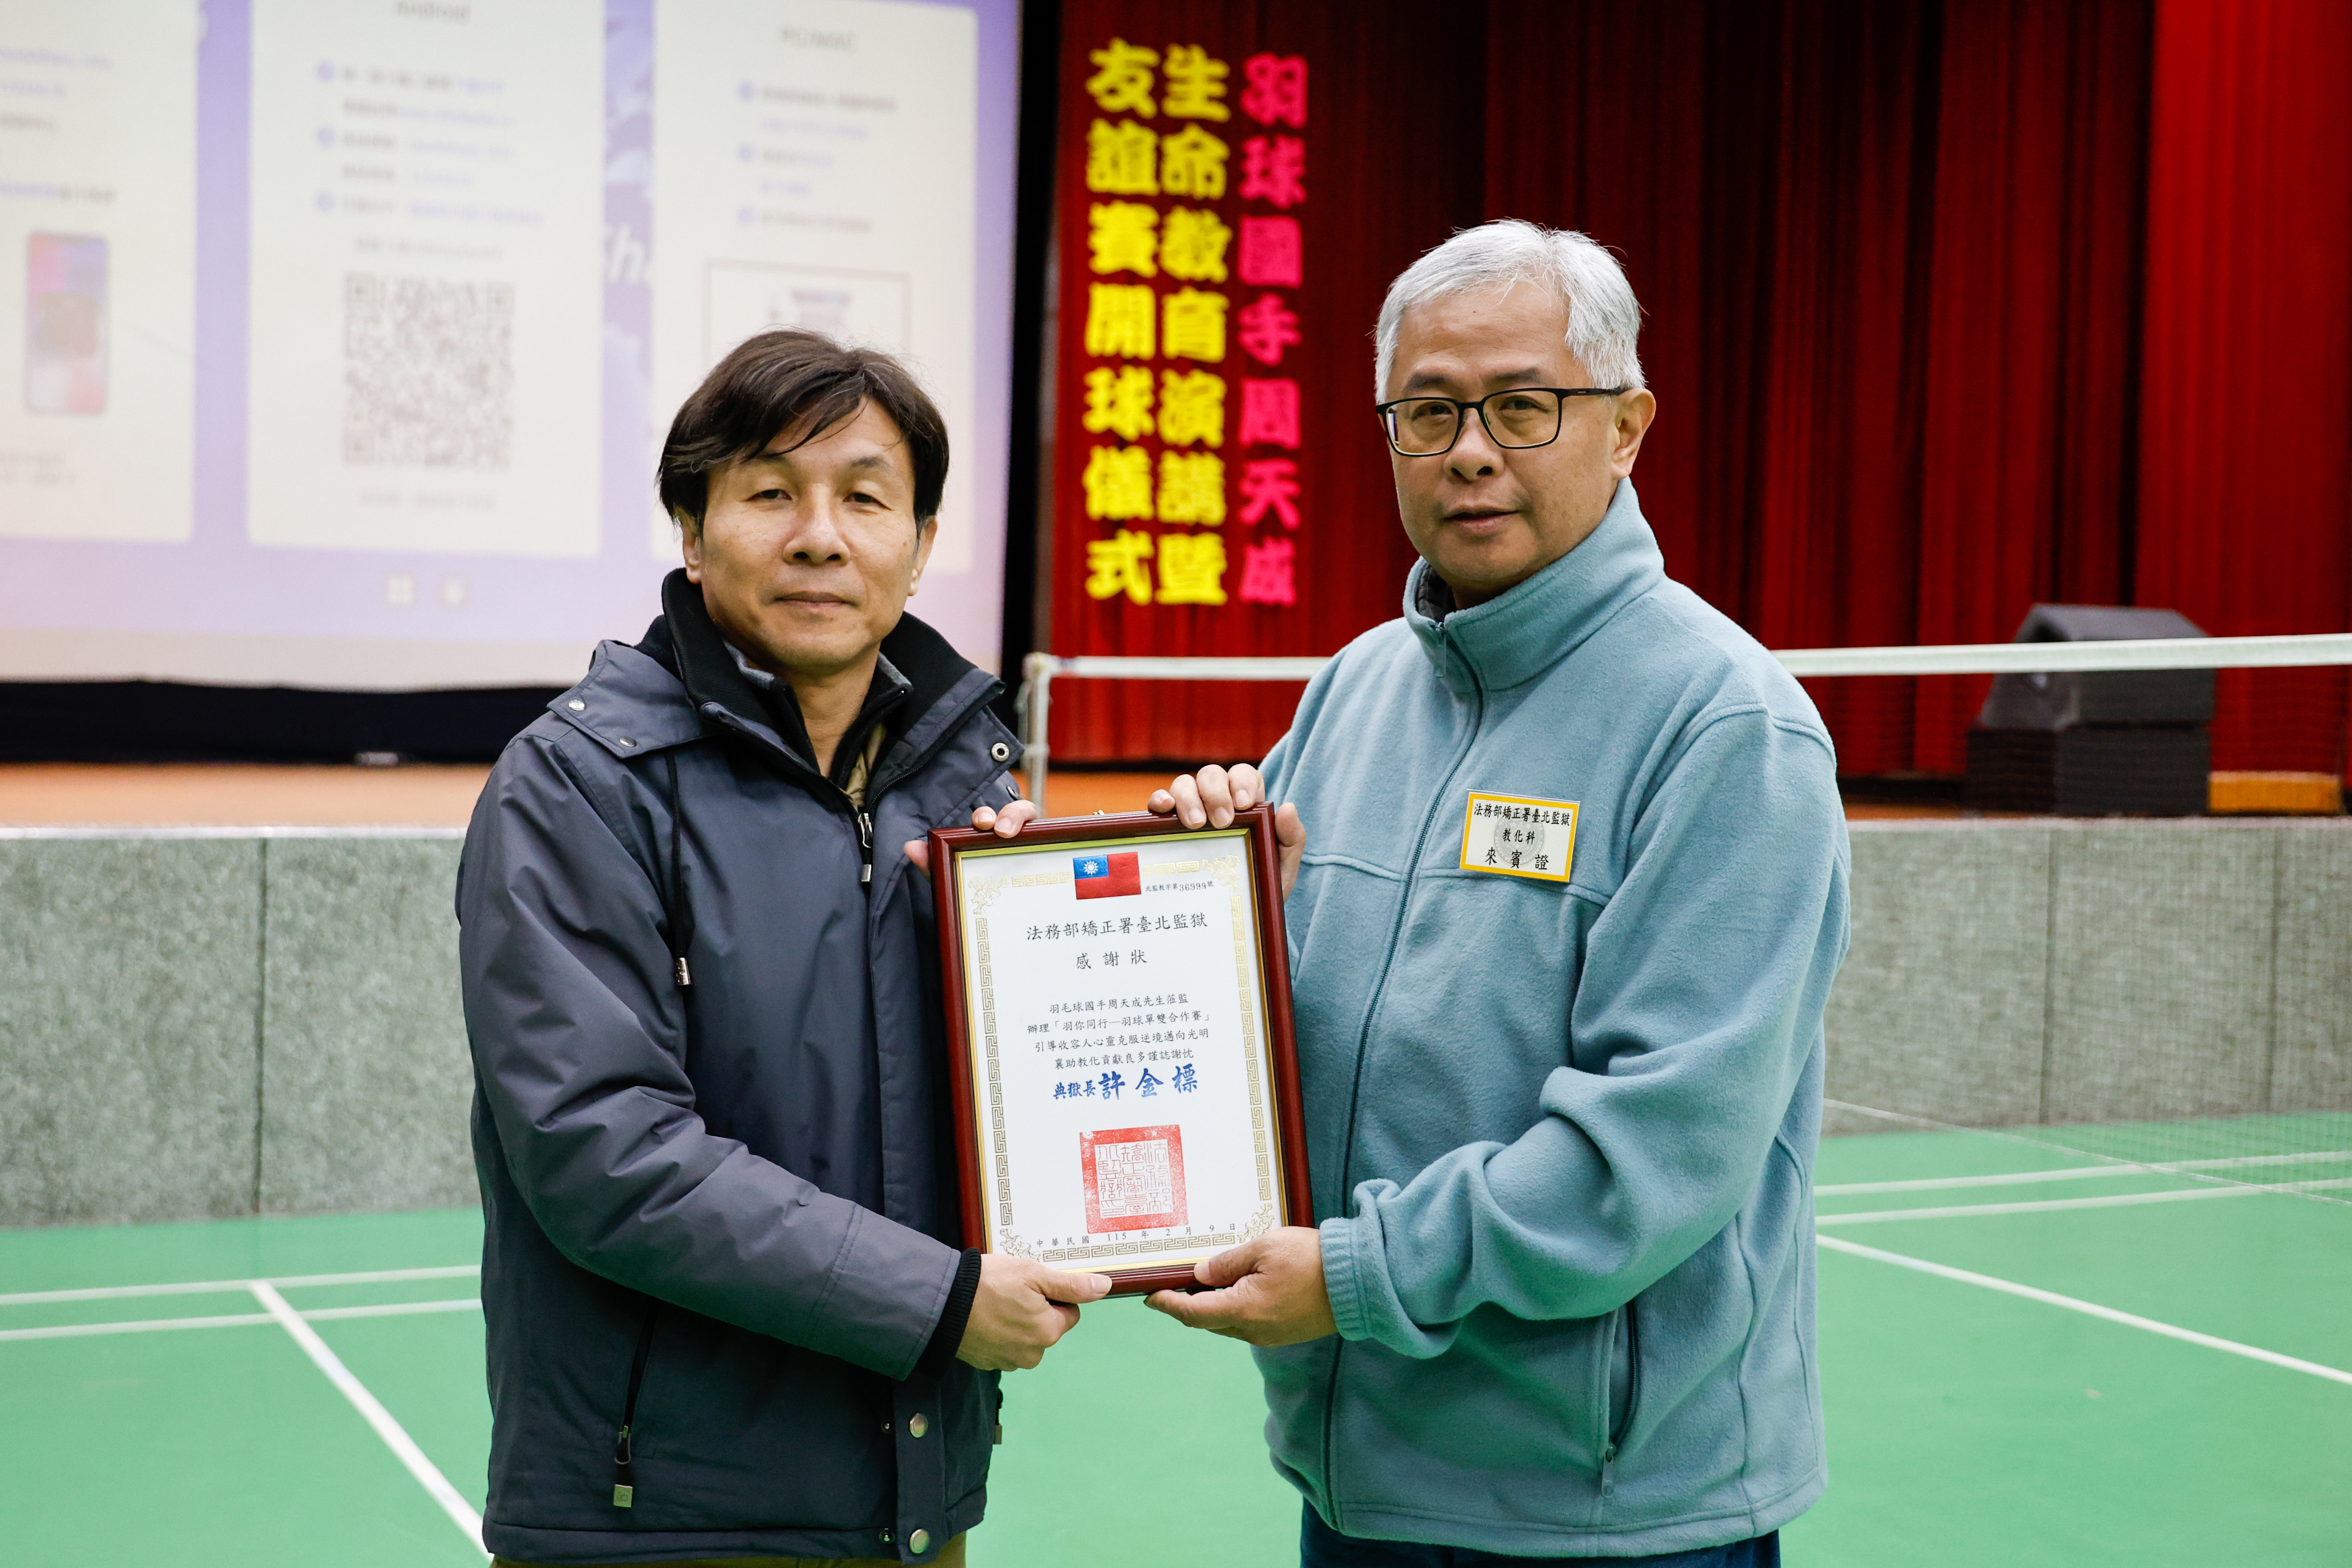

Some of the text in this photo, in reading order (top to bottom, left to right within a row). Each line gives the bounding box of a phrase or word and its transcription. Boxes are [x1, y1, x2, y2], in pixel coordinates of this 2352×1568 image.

[1083, 38, 1160, 605] 友誼賽開球儀式
[1156, 44, 1231, 605] 生命教育演講暨
[1239, 53, 1308, 606] 羽球國手周天成
[1474, 803, 1570, 826] 法務部矯正署臺北監獄
[1503, 828, 1535, 844] 教化科
[1485, 847, 1549, 870] 來賓證
[1027, 913, 1208, 940] 法務部矯正署臺北監獄
[1076, 949, 1147, 969] 感謝狀
[1050, 993, 1188, 1013] 羽毛球國手周天成先生蒞監
[1036, 1029, 1209, 1052] 引導收容人心靈克服逆境邁向光明
[1055, 1049, 1194, 1069] 襄助教化貢獻良多謹誌謝忱
